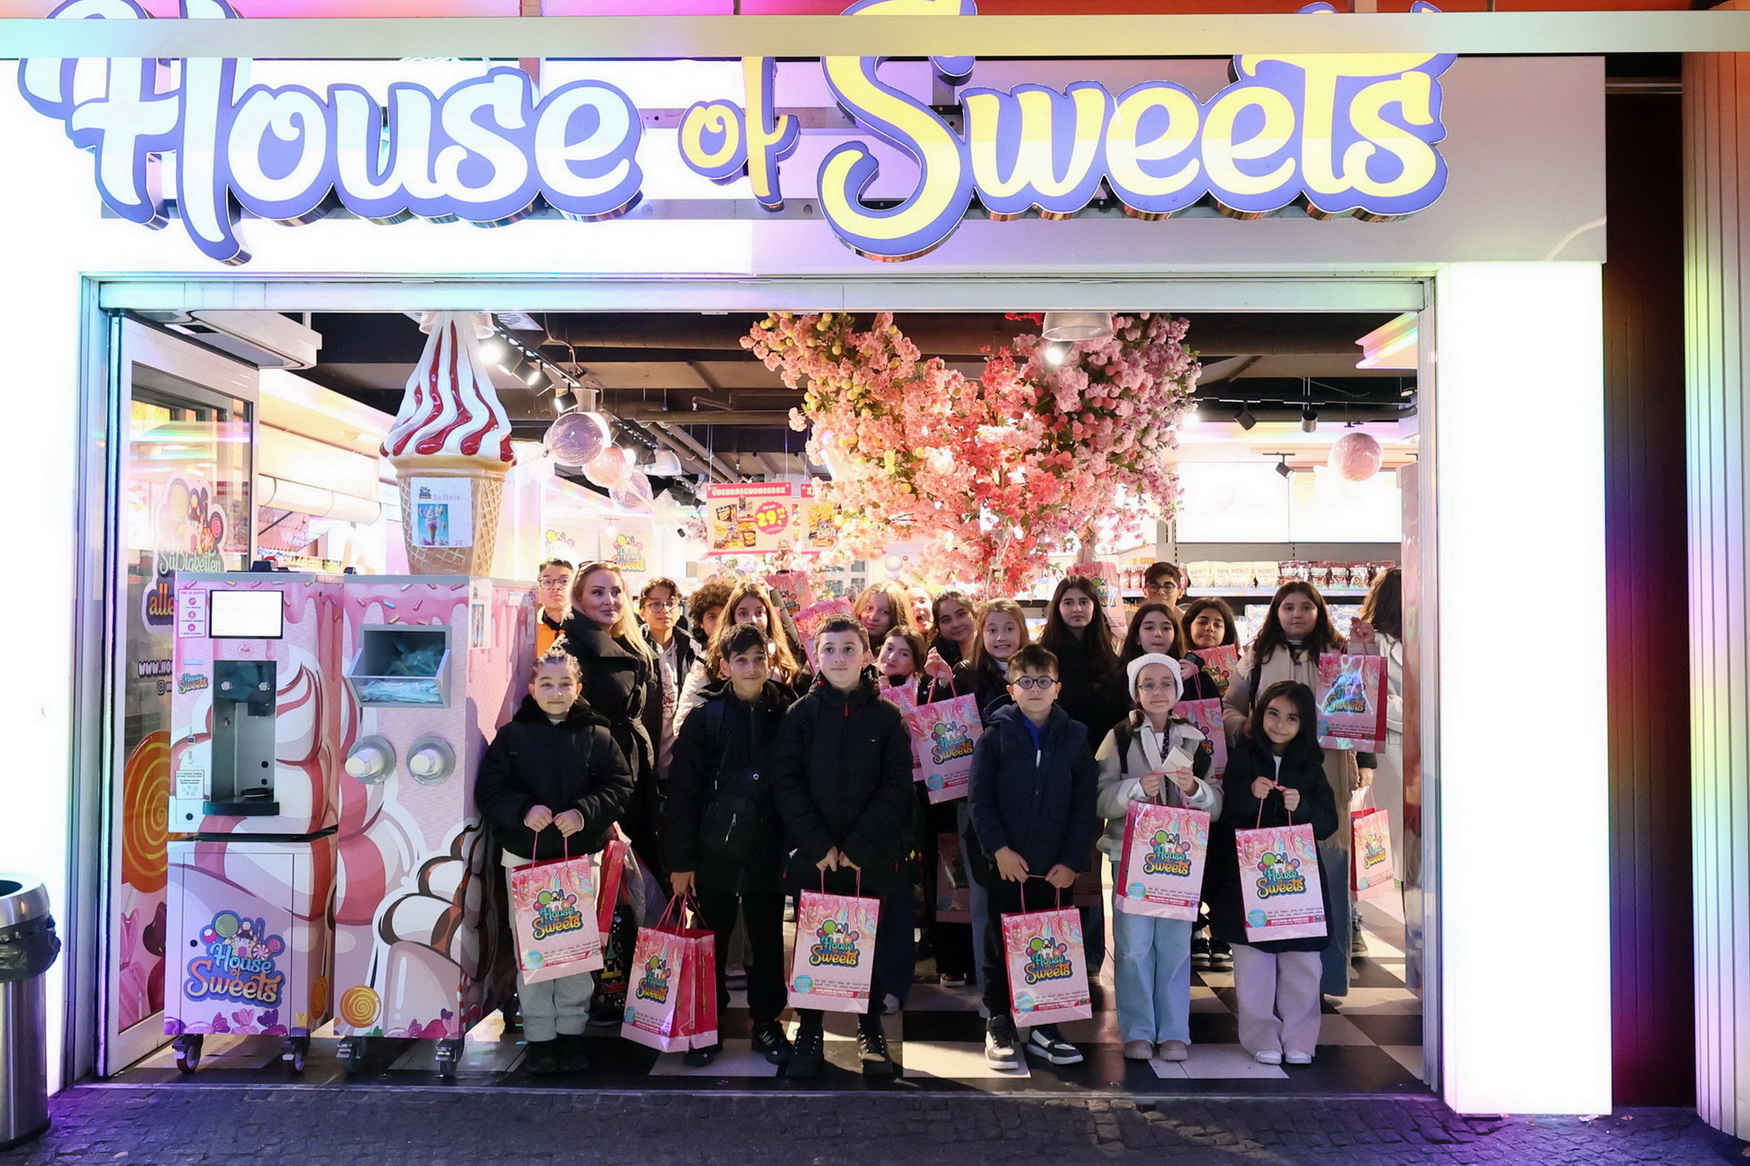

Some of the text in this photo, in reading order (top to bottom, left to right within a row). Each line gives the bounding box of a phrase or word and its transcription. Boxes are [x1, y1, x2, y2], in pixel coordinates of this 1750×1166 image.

[18, 0, 1449, 264] House of Sweets
[931, 740, 974, 764] Sweets
[1153, 844, 1186, 861] House
[1144, 853, 1190, 875] Sweets
[1263, 868, 1298, 882] House
[1256, 876, 1305, 898] Sweets
[539, 907, 574, 920] House
[532, 913, 582, 939] Sweets
[821, 935, 854, 951] House
[209, 942, 272, 973] House
[810, 944, 859, 965] Sweets
[1031, 953, 1065, 967] House
[186, 959, 282, 1002] Sweets
[230, 965, 243, 981] of
[1024, 961, 1071, 983] Sweets
